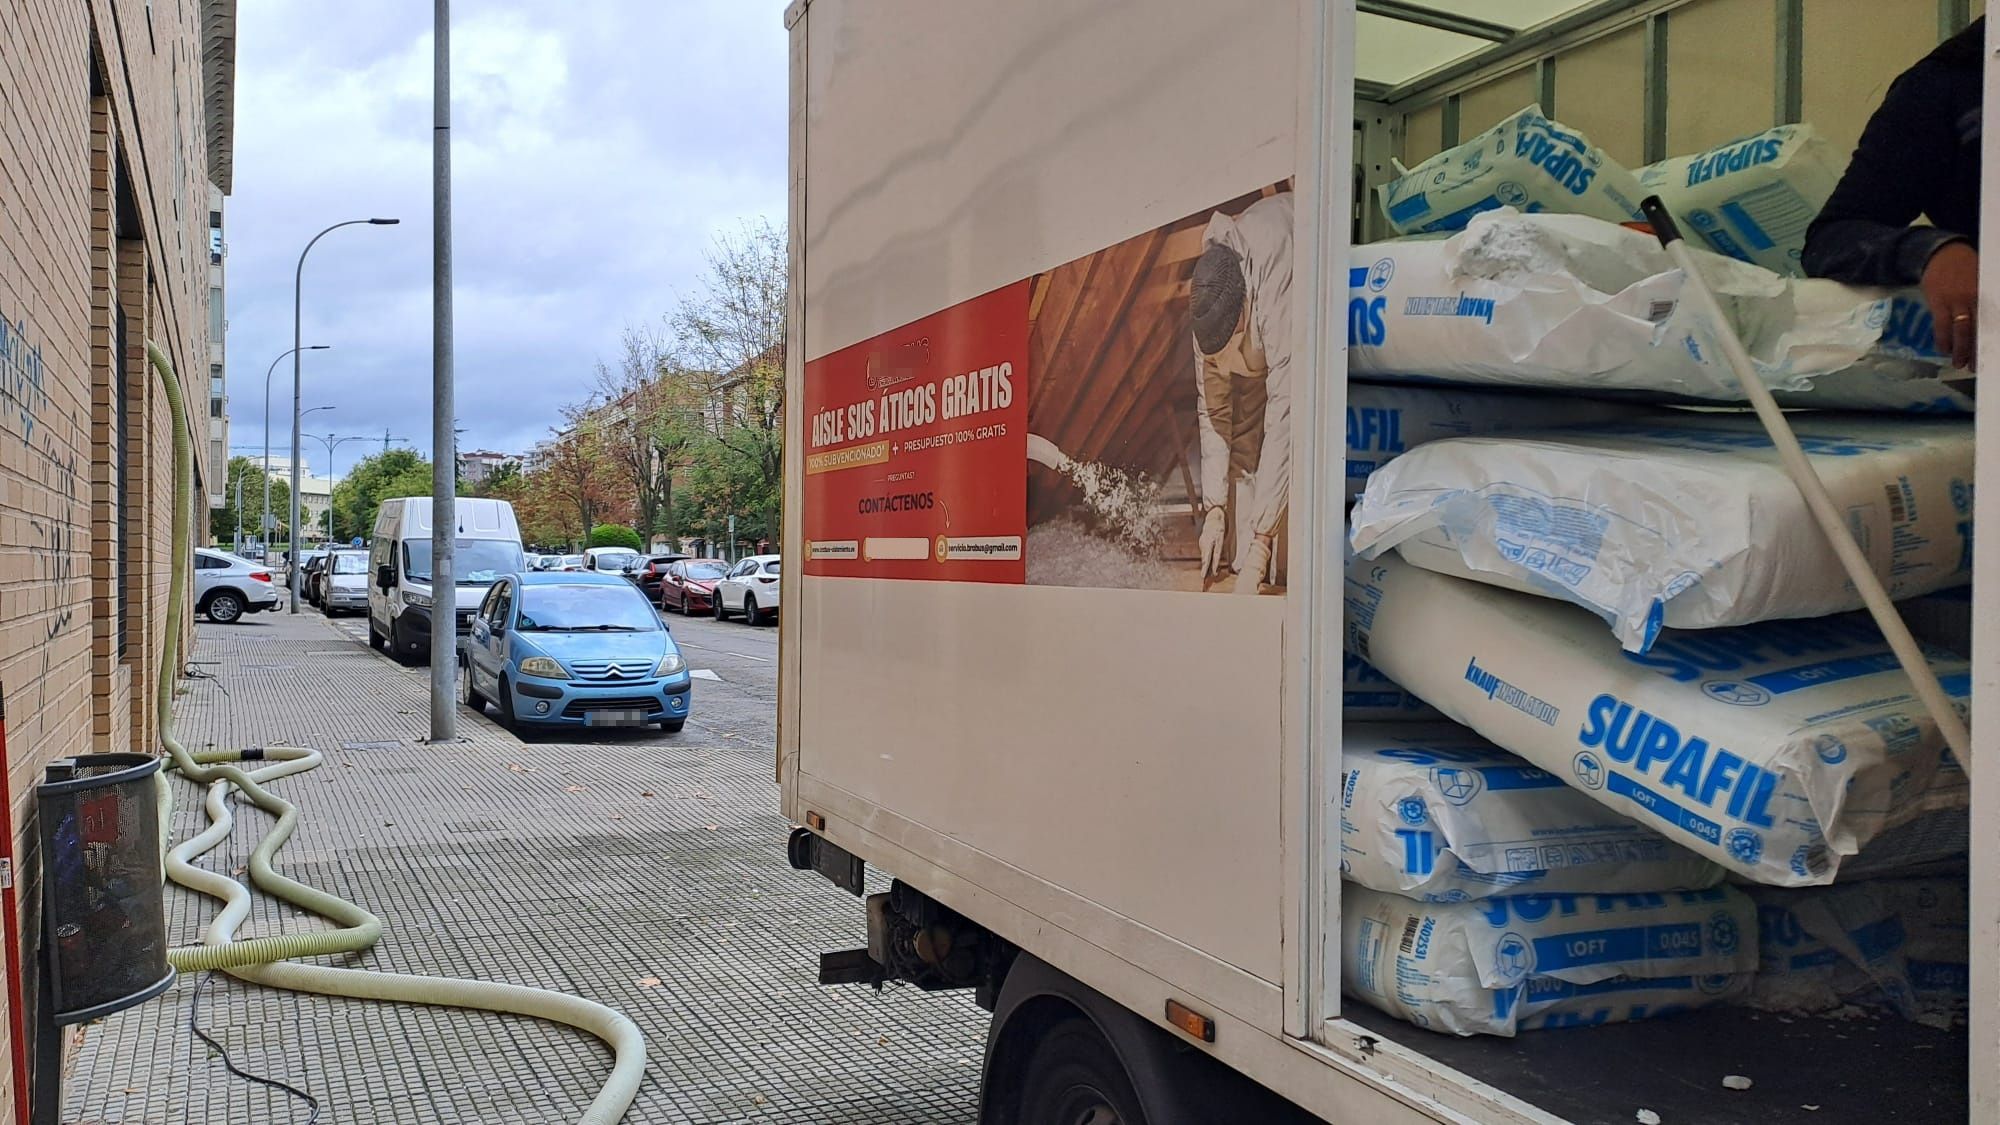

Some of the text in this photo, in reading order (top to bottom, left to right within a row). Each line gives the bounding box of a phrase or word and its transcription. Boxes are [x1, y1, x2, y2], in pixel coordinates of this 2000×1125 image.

[1686, 139, 1784, 188] SUPAFIL
[811, 407, 844, 448] AÍSLE
[847, 399, 874, 438] SUS
[879, 382, 936, 433] ÁTICOS
[942, 362, 1013, 421] GRATIS
[904, 433, 953, 453] PRESUPUESTO
[955, 430, 974, 443] 100%
[977, 423, 1007, 439] GRATIS
[1579, 694, 1779, 828] SUPAFIL
[1344, 769, 1360, 808] 2402531
[1632, 787, 1657, 809] LOFT
[1414, 916, 1436, 960] 2402531
[1566, 939, 1607, 958] LOFT
